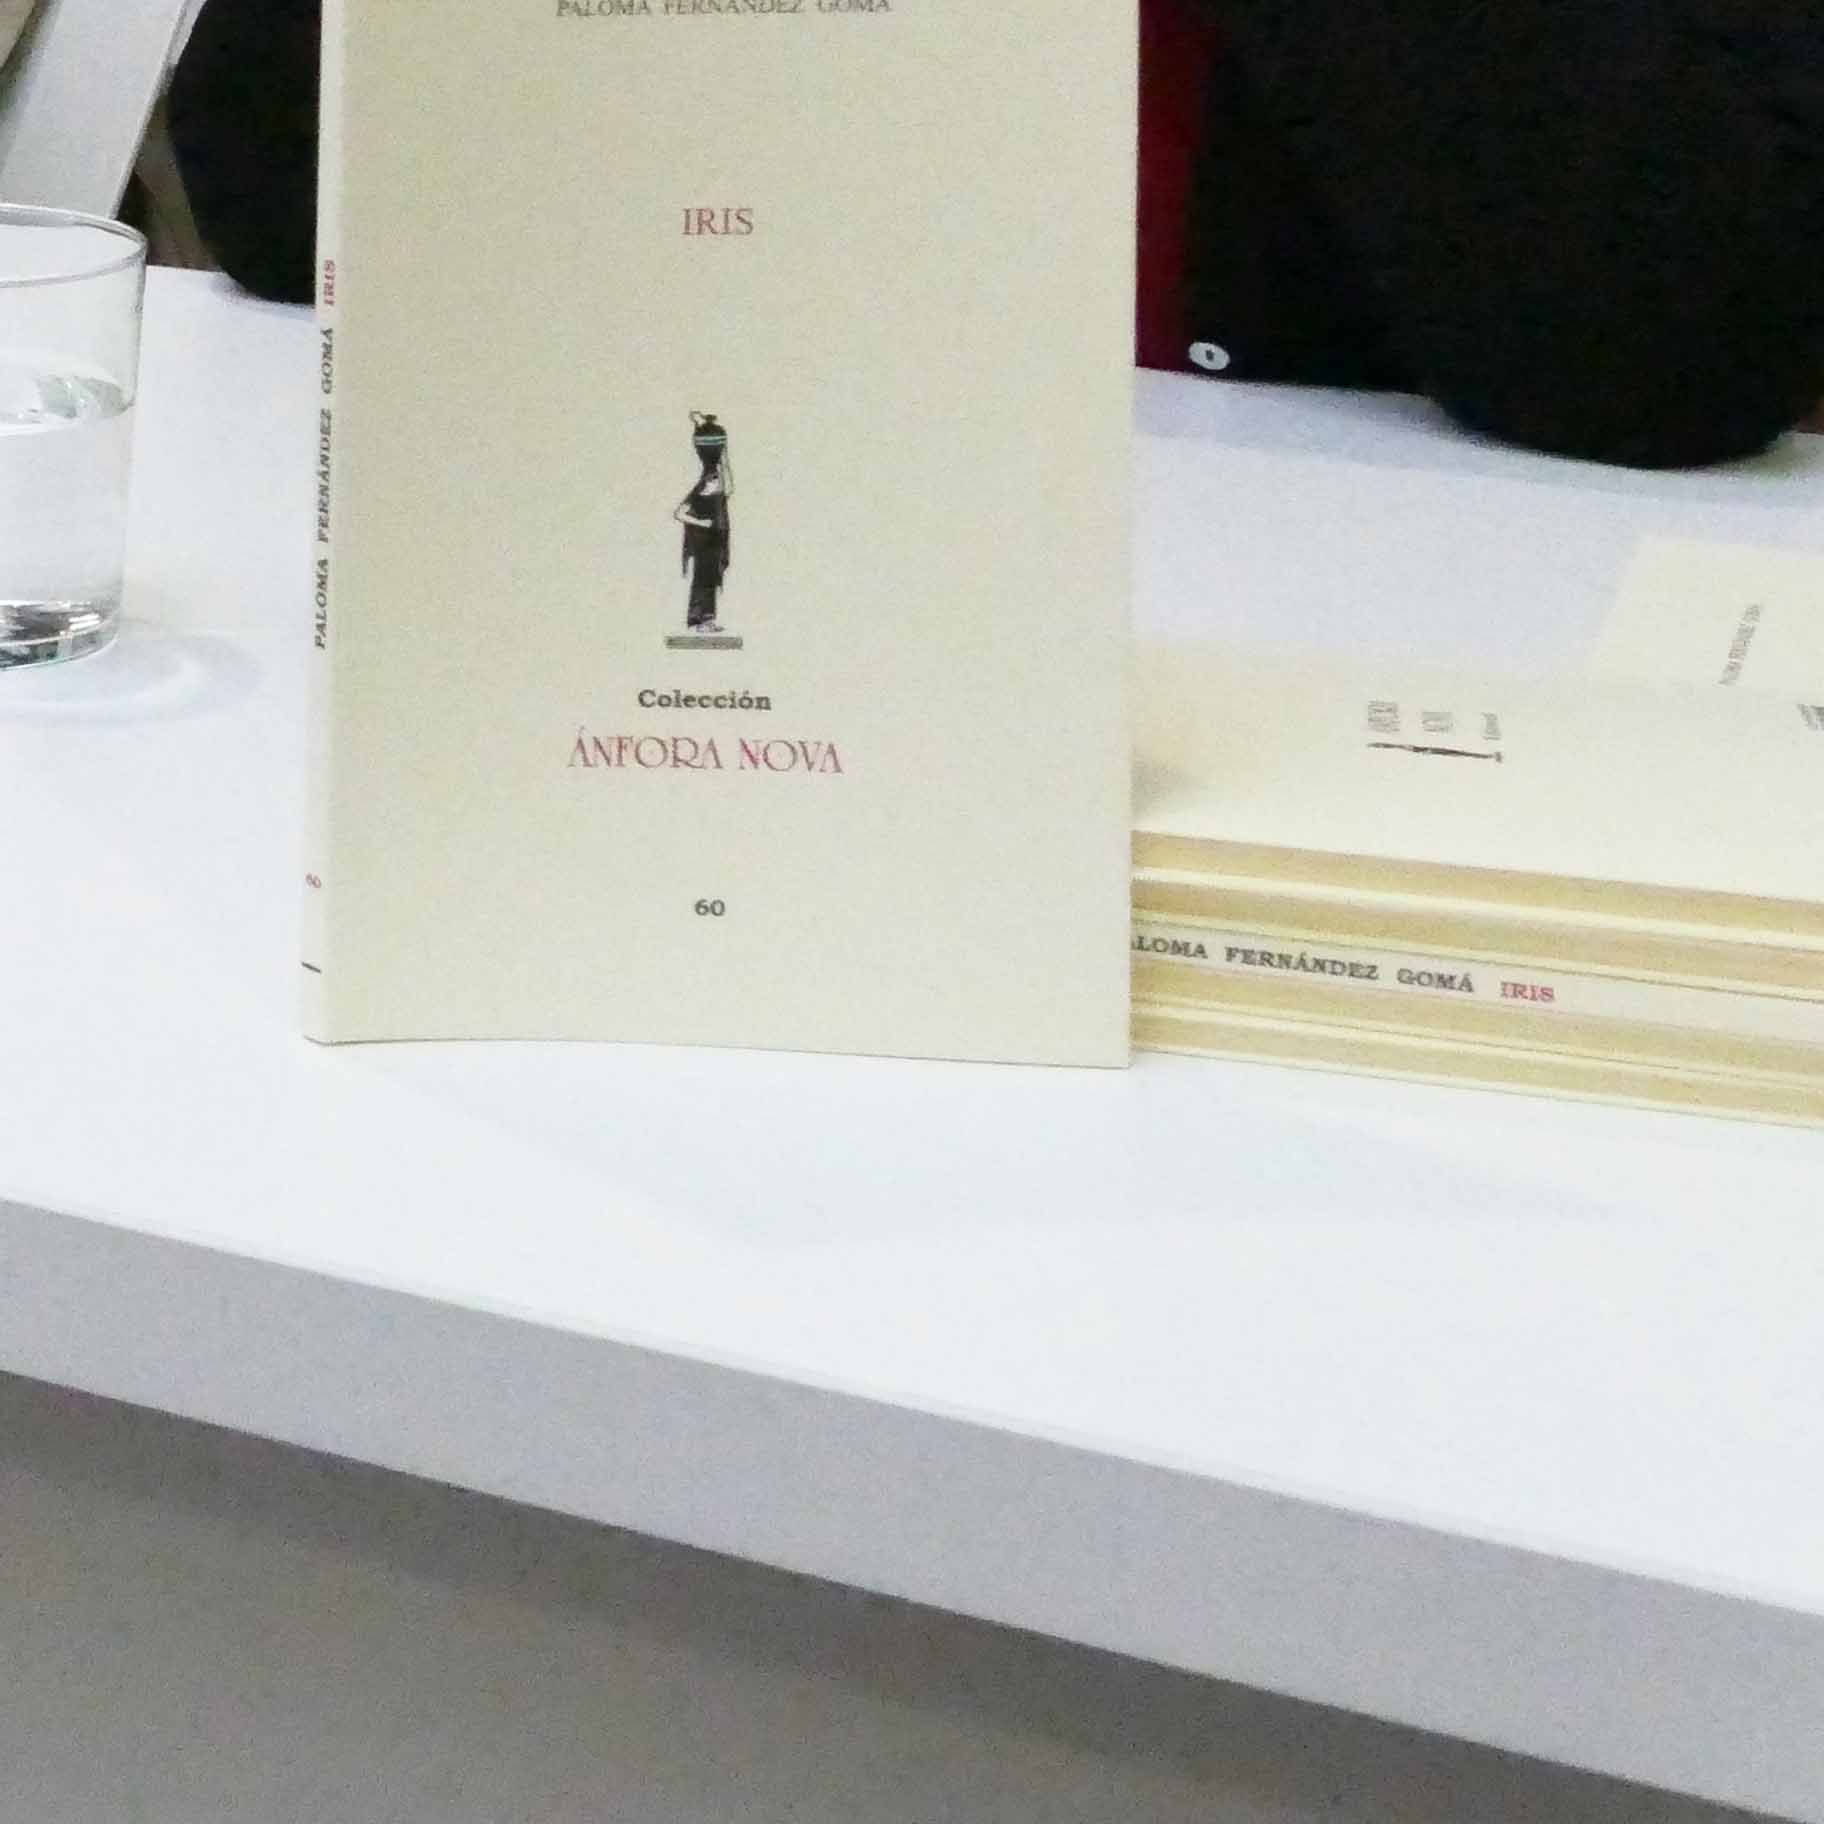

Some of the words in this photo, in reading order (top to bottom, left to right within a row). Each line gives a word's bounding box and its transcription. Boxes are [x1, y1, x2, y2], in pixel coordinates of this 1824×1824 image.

[682, 208, 754, 236] IRIS
[315, 557, 329, 650] PALOMA
[324, 259, 336, 307] IRIS
[637, 689, 772, 711] Colección
[567, 725, 725, 770] ÁNFORA
[738, 737, 844, 774] NOVA
[694, 898, 726, 917] 60
[1224, 945, 1380, 981] FERNÁNDEZ
[1397, 968, 1475, 994] GOMÁ
[1500, 981, 1556, 1004] IRIS
